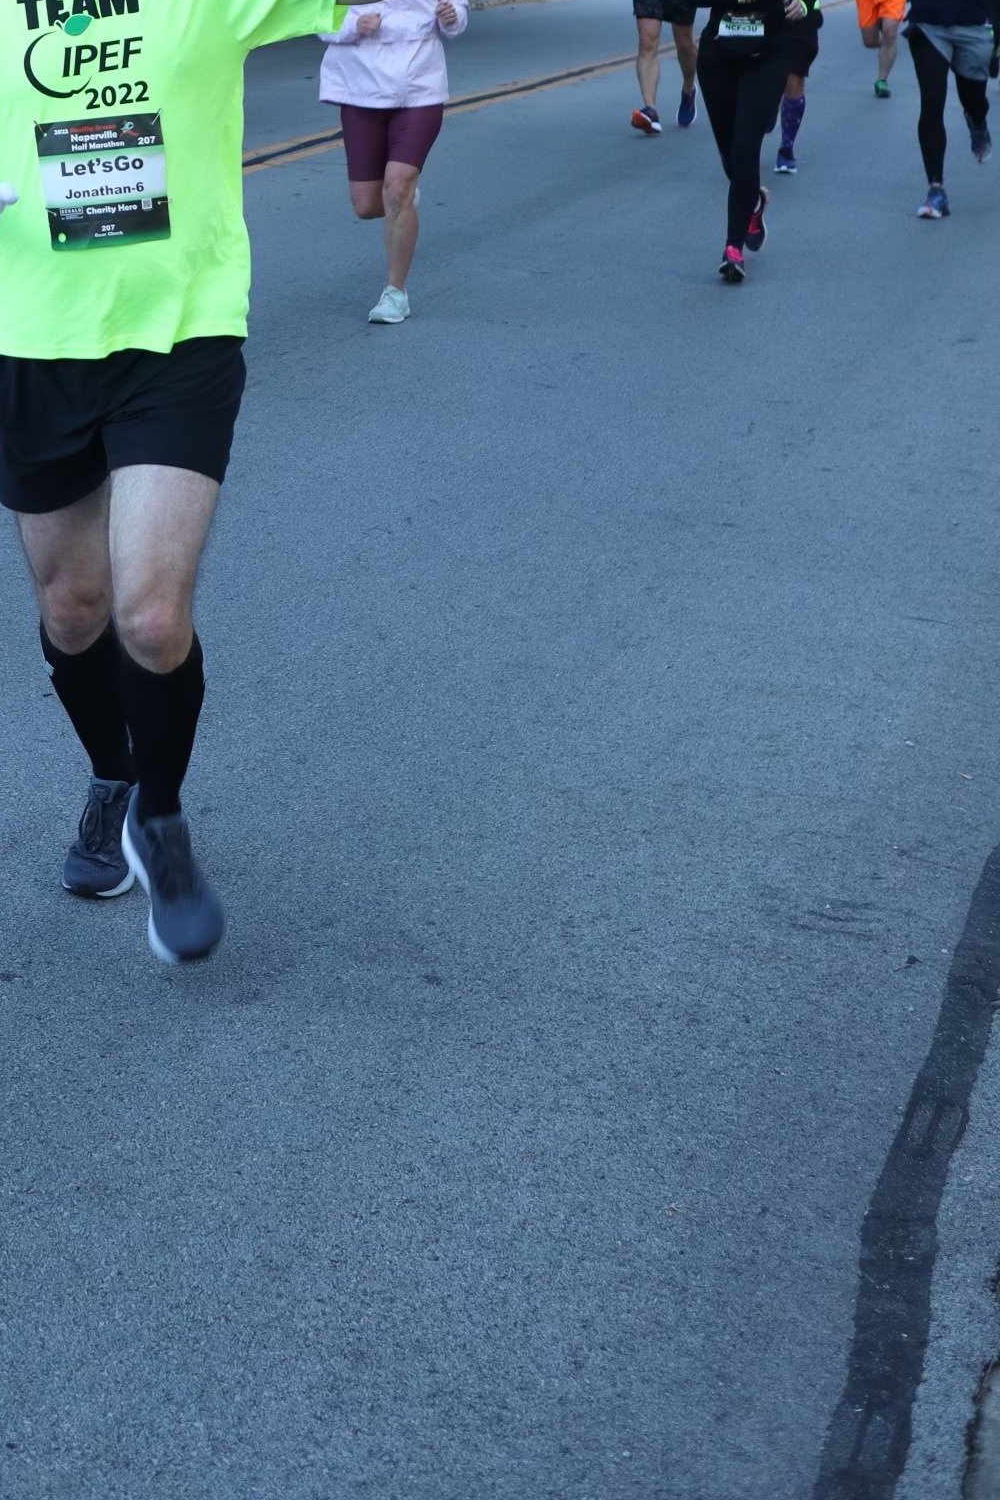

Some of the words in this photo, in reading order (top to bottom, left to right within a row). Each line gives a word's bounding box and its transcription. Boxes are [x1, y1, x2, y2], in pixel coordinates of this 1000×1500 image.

[61, 36, 143, 78] IPEF
[84, 80, 150, 110] 2022
[53, 128, 69, 136] 2022
[70, 130, 118, 143] Naperville
[71, 143, 88, 152] Half
[89, 140, 125, 150] Marathon
[137, 135, 156, 145] 207
[65, 181, 145, 200] Jonathan-6
[86, 206, 117, 215] Charity
[117, 203, 138, 212] Hero
[101, 224, 116, 232] 207
